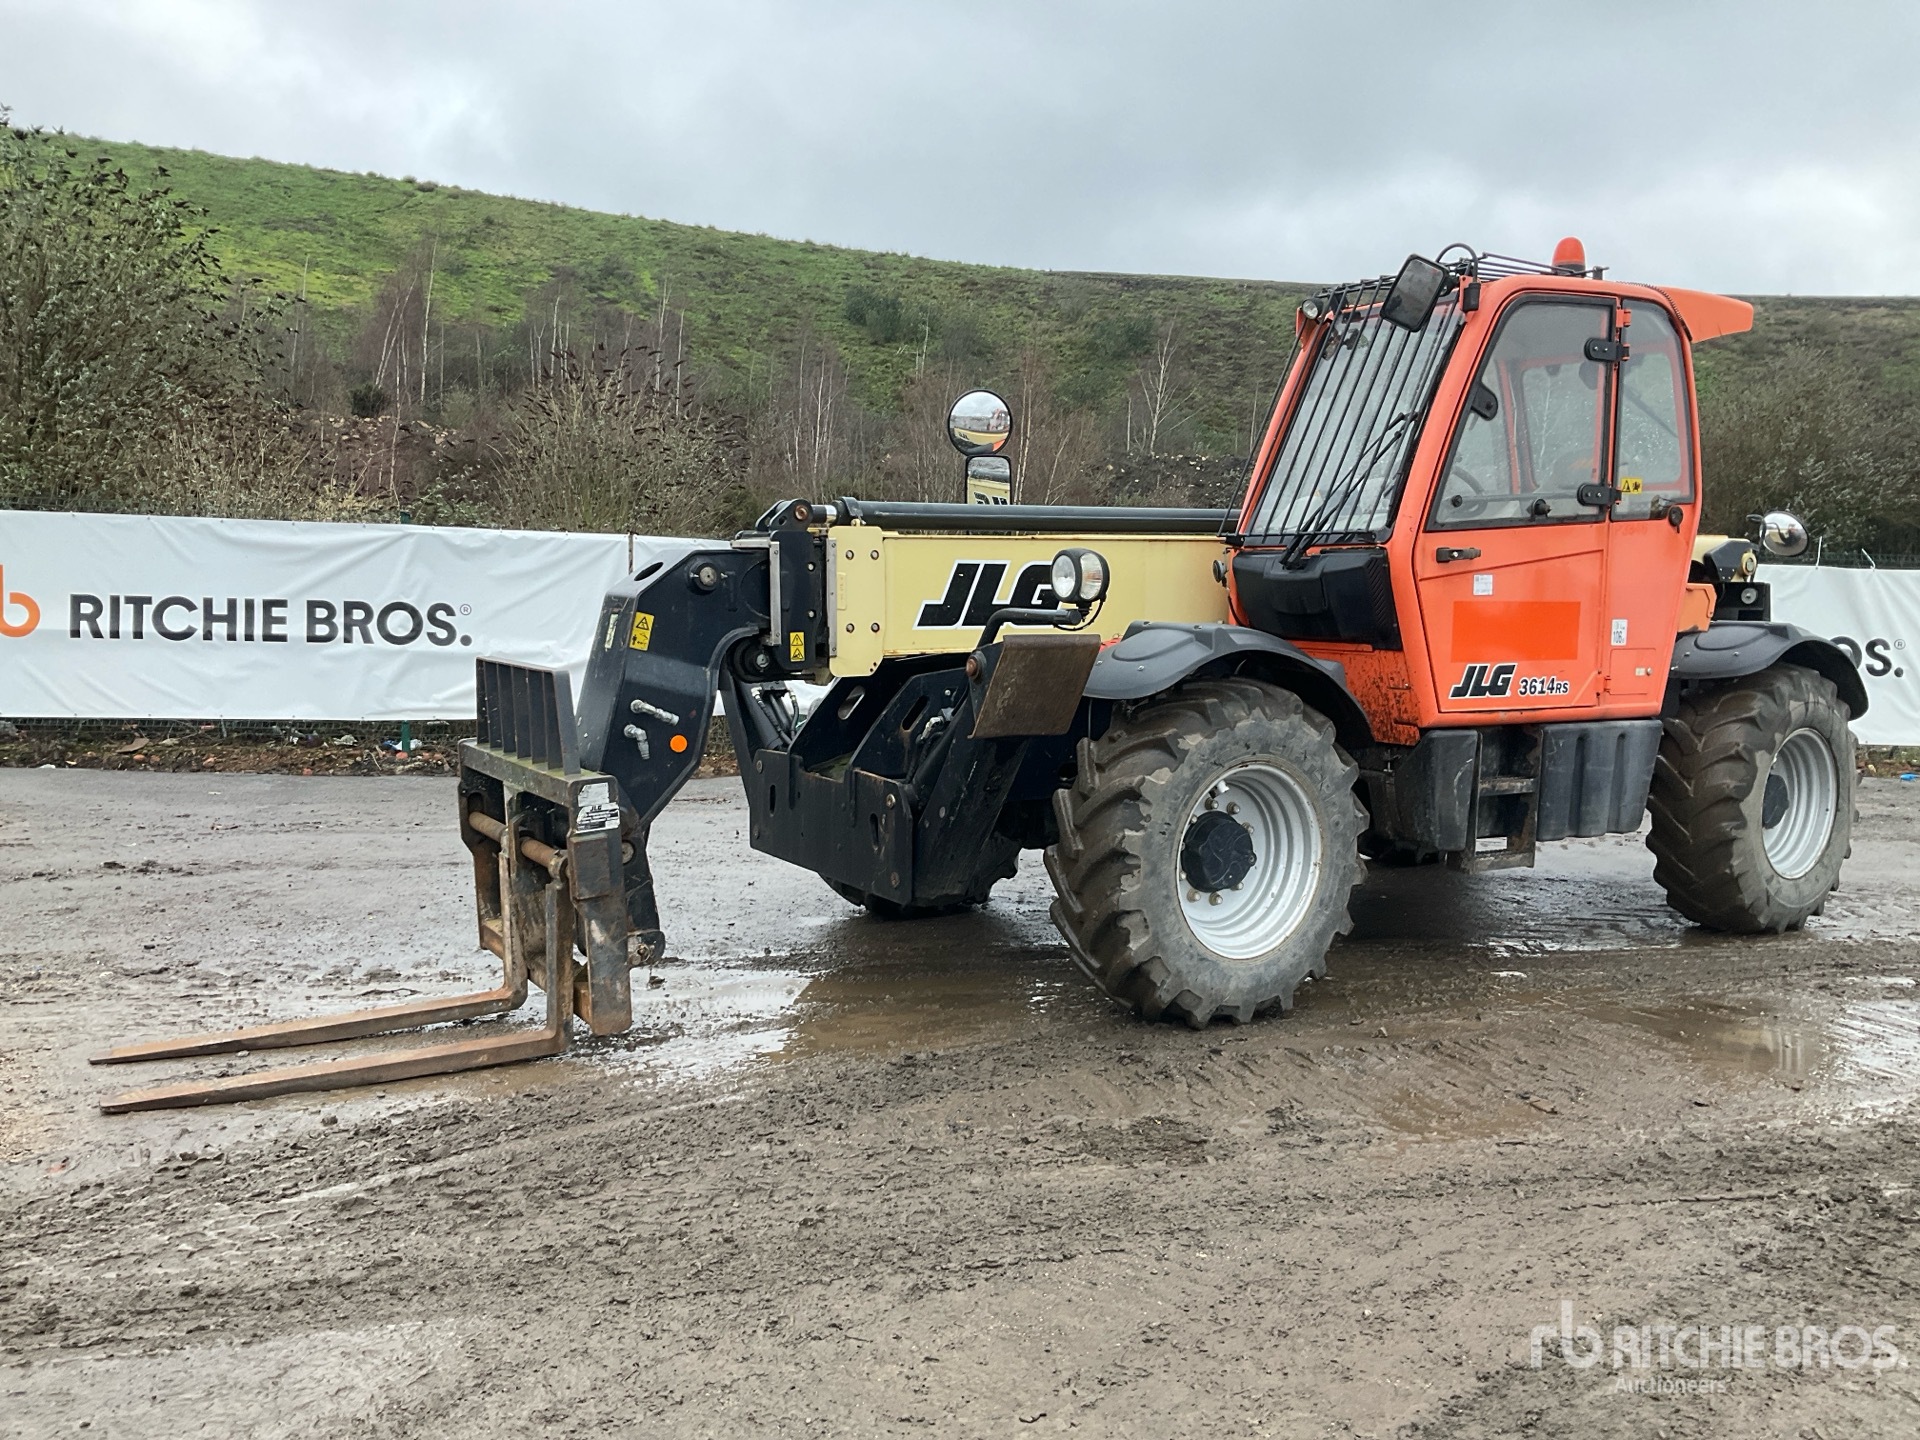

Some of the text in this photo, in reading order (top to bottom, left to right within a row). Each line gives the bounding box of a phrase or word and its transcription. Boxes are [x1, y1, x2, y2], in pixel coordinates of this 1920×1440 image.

[69, 593, 288, 642] RITCHIE
[916, 562, 1061, 627] JLG
[1450, 664, 1569, 698] JLG 3614RS
